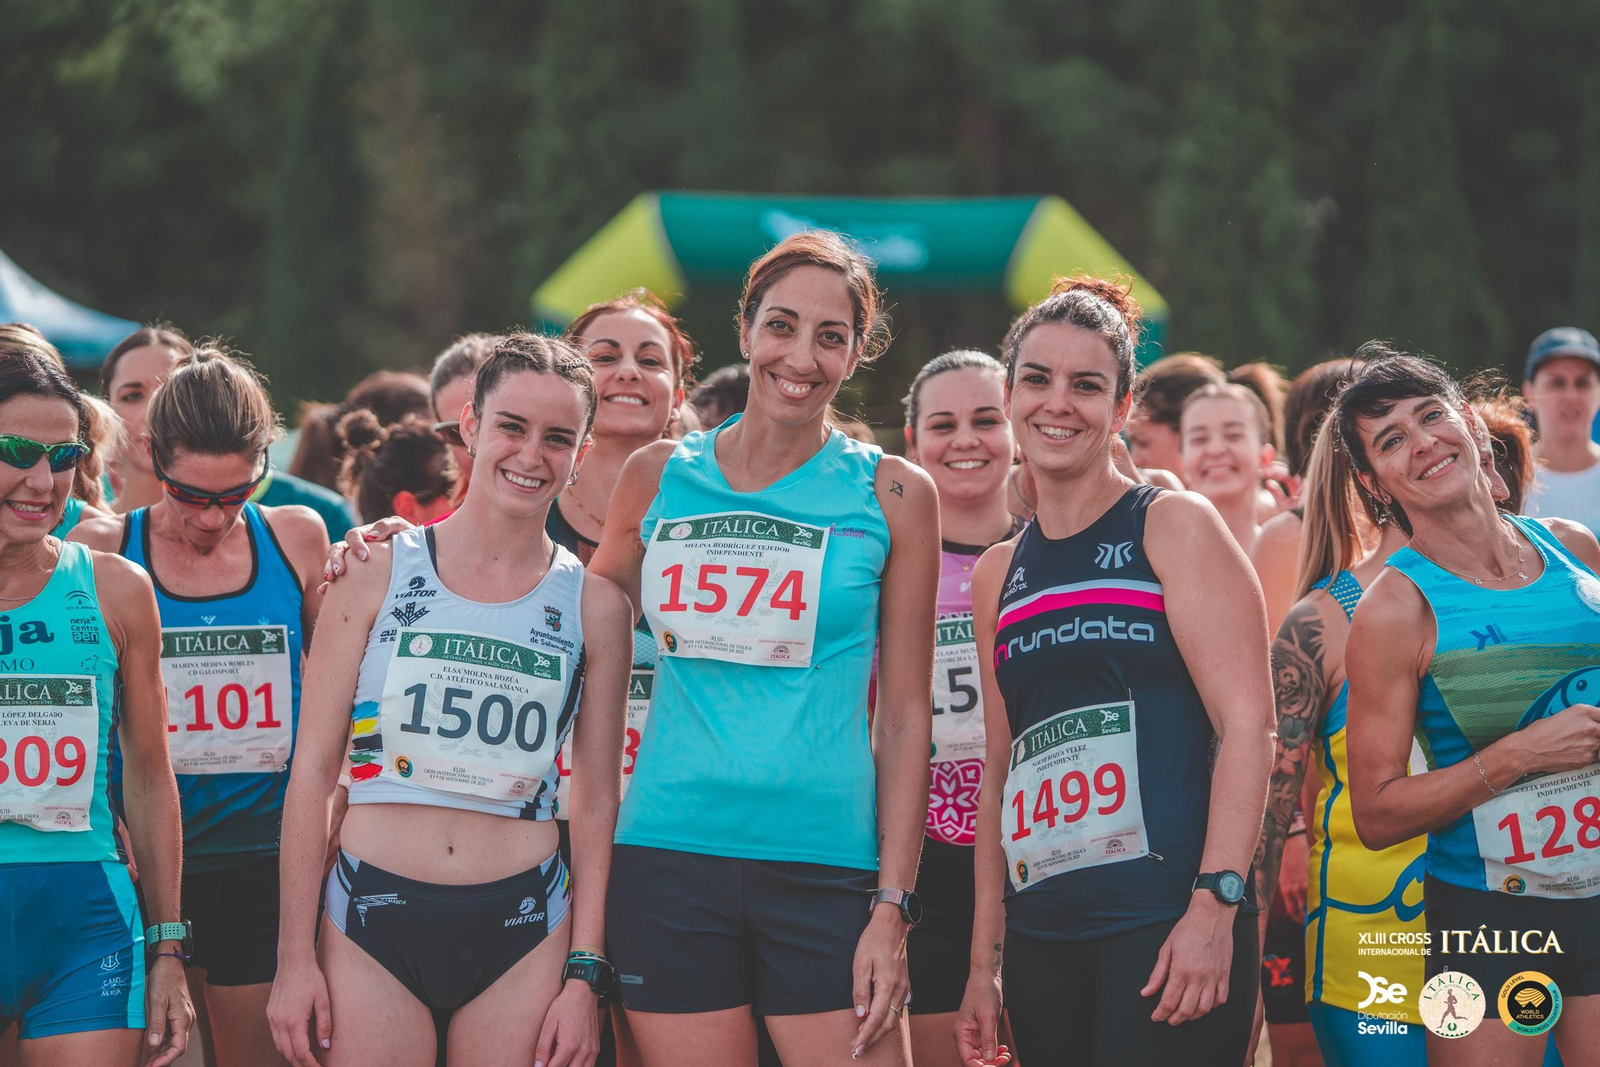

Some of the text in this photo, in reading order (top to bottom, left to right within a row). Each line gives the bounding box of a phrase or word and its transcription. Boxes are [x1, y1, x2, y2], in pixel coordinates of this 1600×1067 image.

[702, 516, 779, 537] ITÁLICA
[706, 549, 764, 558] INDEPENDIENTE
[712, 541, 756, 550] RODRÍGUEZ
[757, 544, 791, 553] TEJEDOR
[659, 563, 807, 621] 1574
[175, 633, 251, 652] ITÁLICA
[529, 627, 575, 649] Ayuntamiento
[530, 636, 539, 644] de
[443, 637, 523, 667] ITÁLICA
[443, 665, 462, 675] ELSA
[462, 666, 493, 680] MOLINA
[0, 683, 52, 701] LICA
[430, 672, 530, 694] C.D. ATLÉTICO SALAMANCA
[2, 710, 27, 718] LÓPEZ
[400, 683, 547, 753] 1500
[1031, 717, 1088, 752] ITÁLICA
[1101, 726, 1121, 735] Sevilla
[1065, 744, 1088, 754] VÉLEZ
[1036, 754, 1080, 773] INDEPENDIENTE
[1537, 779, 1592, 798] INDEPENDIENTE
[1539, 776, 1570, 789] ROMERO
[1011, 762, 1127, 843] 1499
[1497, 796, 1600, 865] 128
[503, 911, 545, 928] VIATOR
